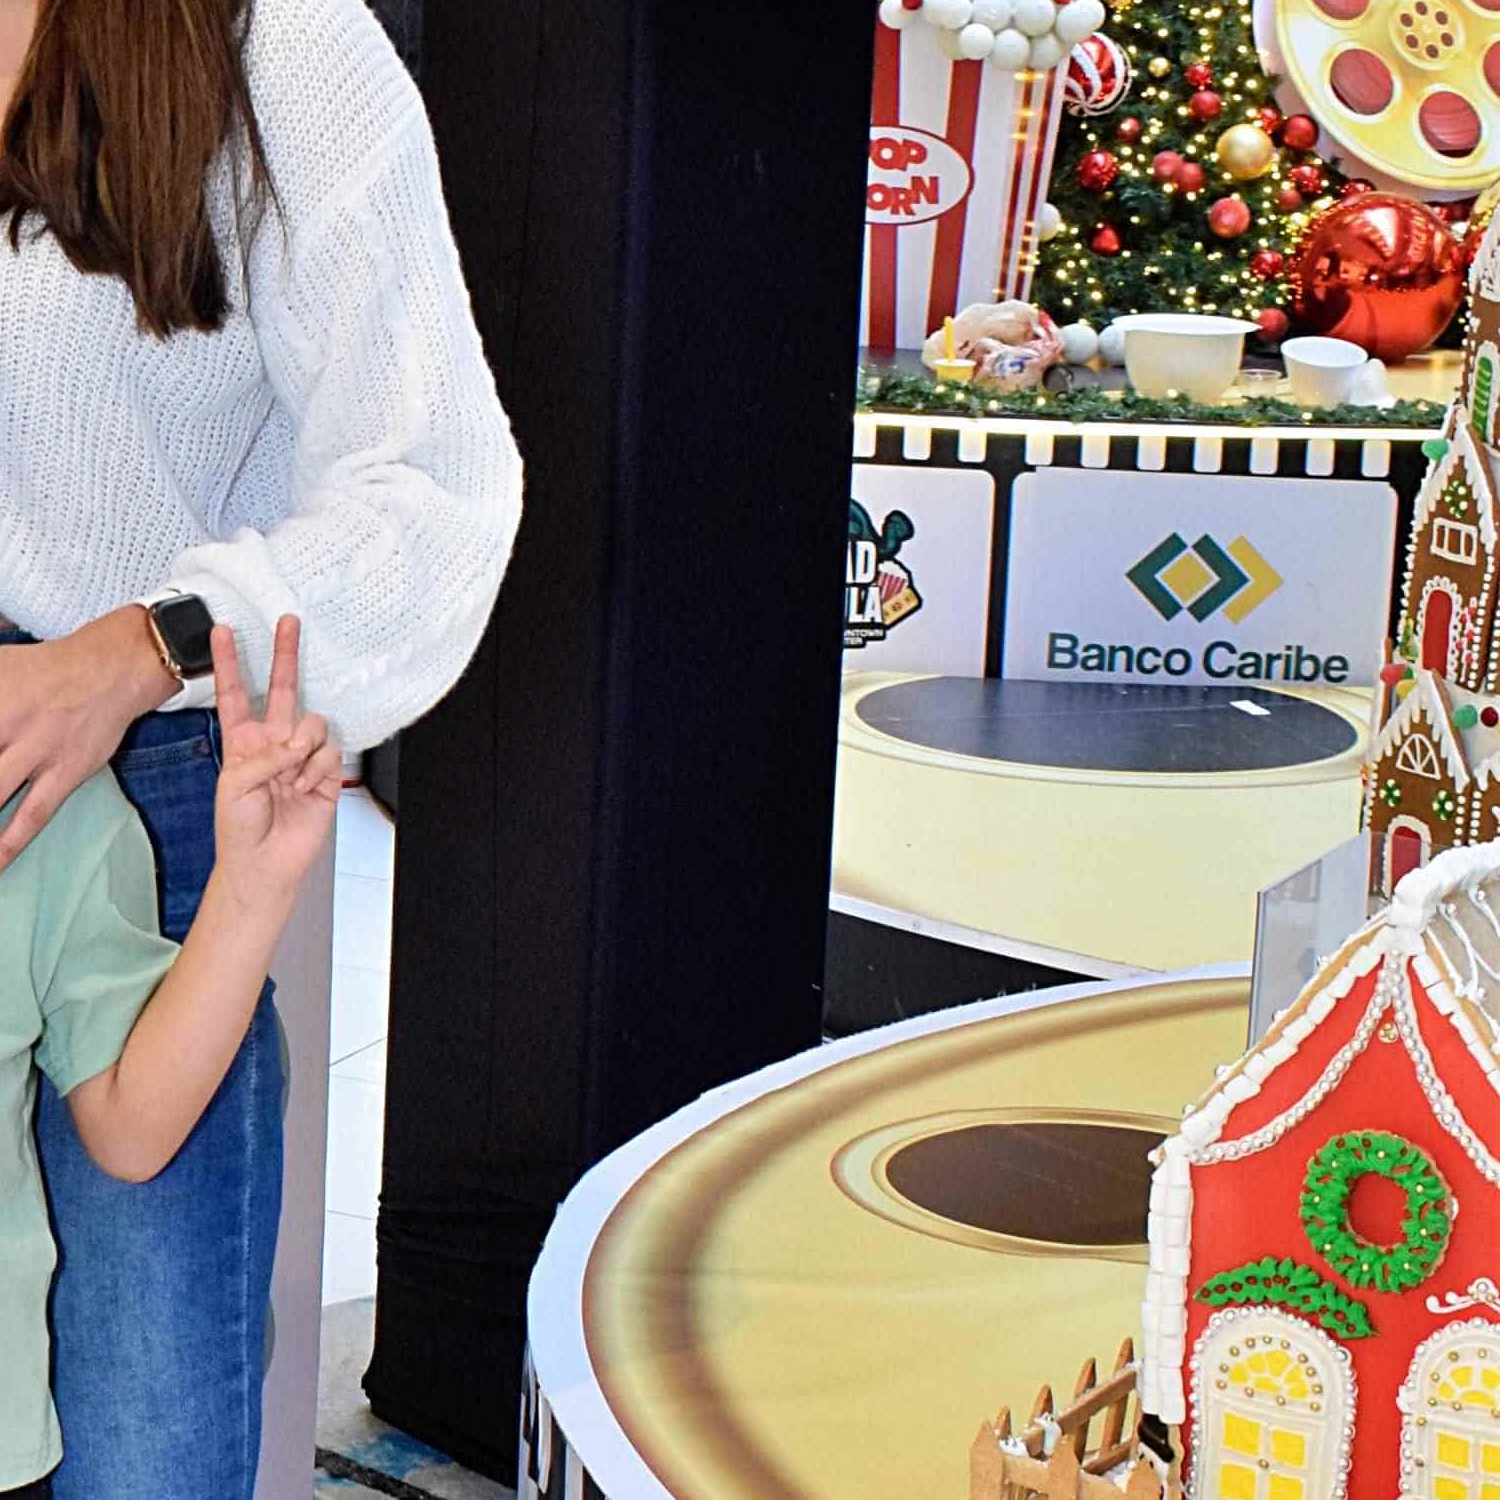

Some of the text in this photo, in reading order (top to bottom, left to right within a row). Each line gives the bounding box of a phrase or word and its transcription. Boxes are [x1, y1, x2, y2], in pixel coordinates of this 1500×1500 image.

[868, 136, 929, 172] OP
[866, 174, 941, 217] ORN
[1047, 632, 1350, 684] Banco Caribe
